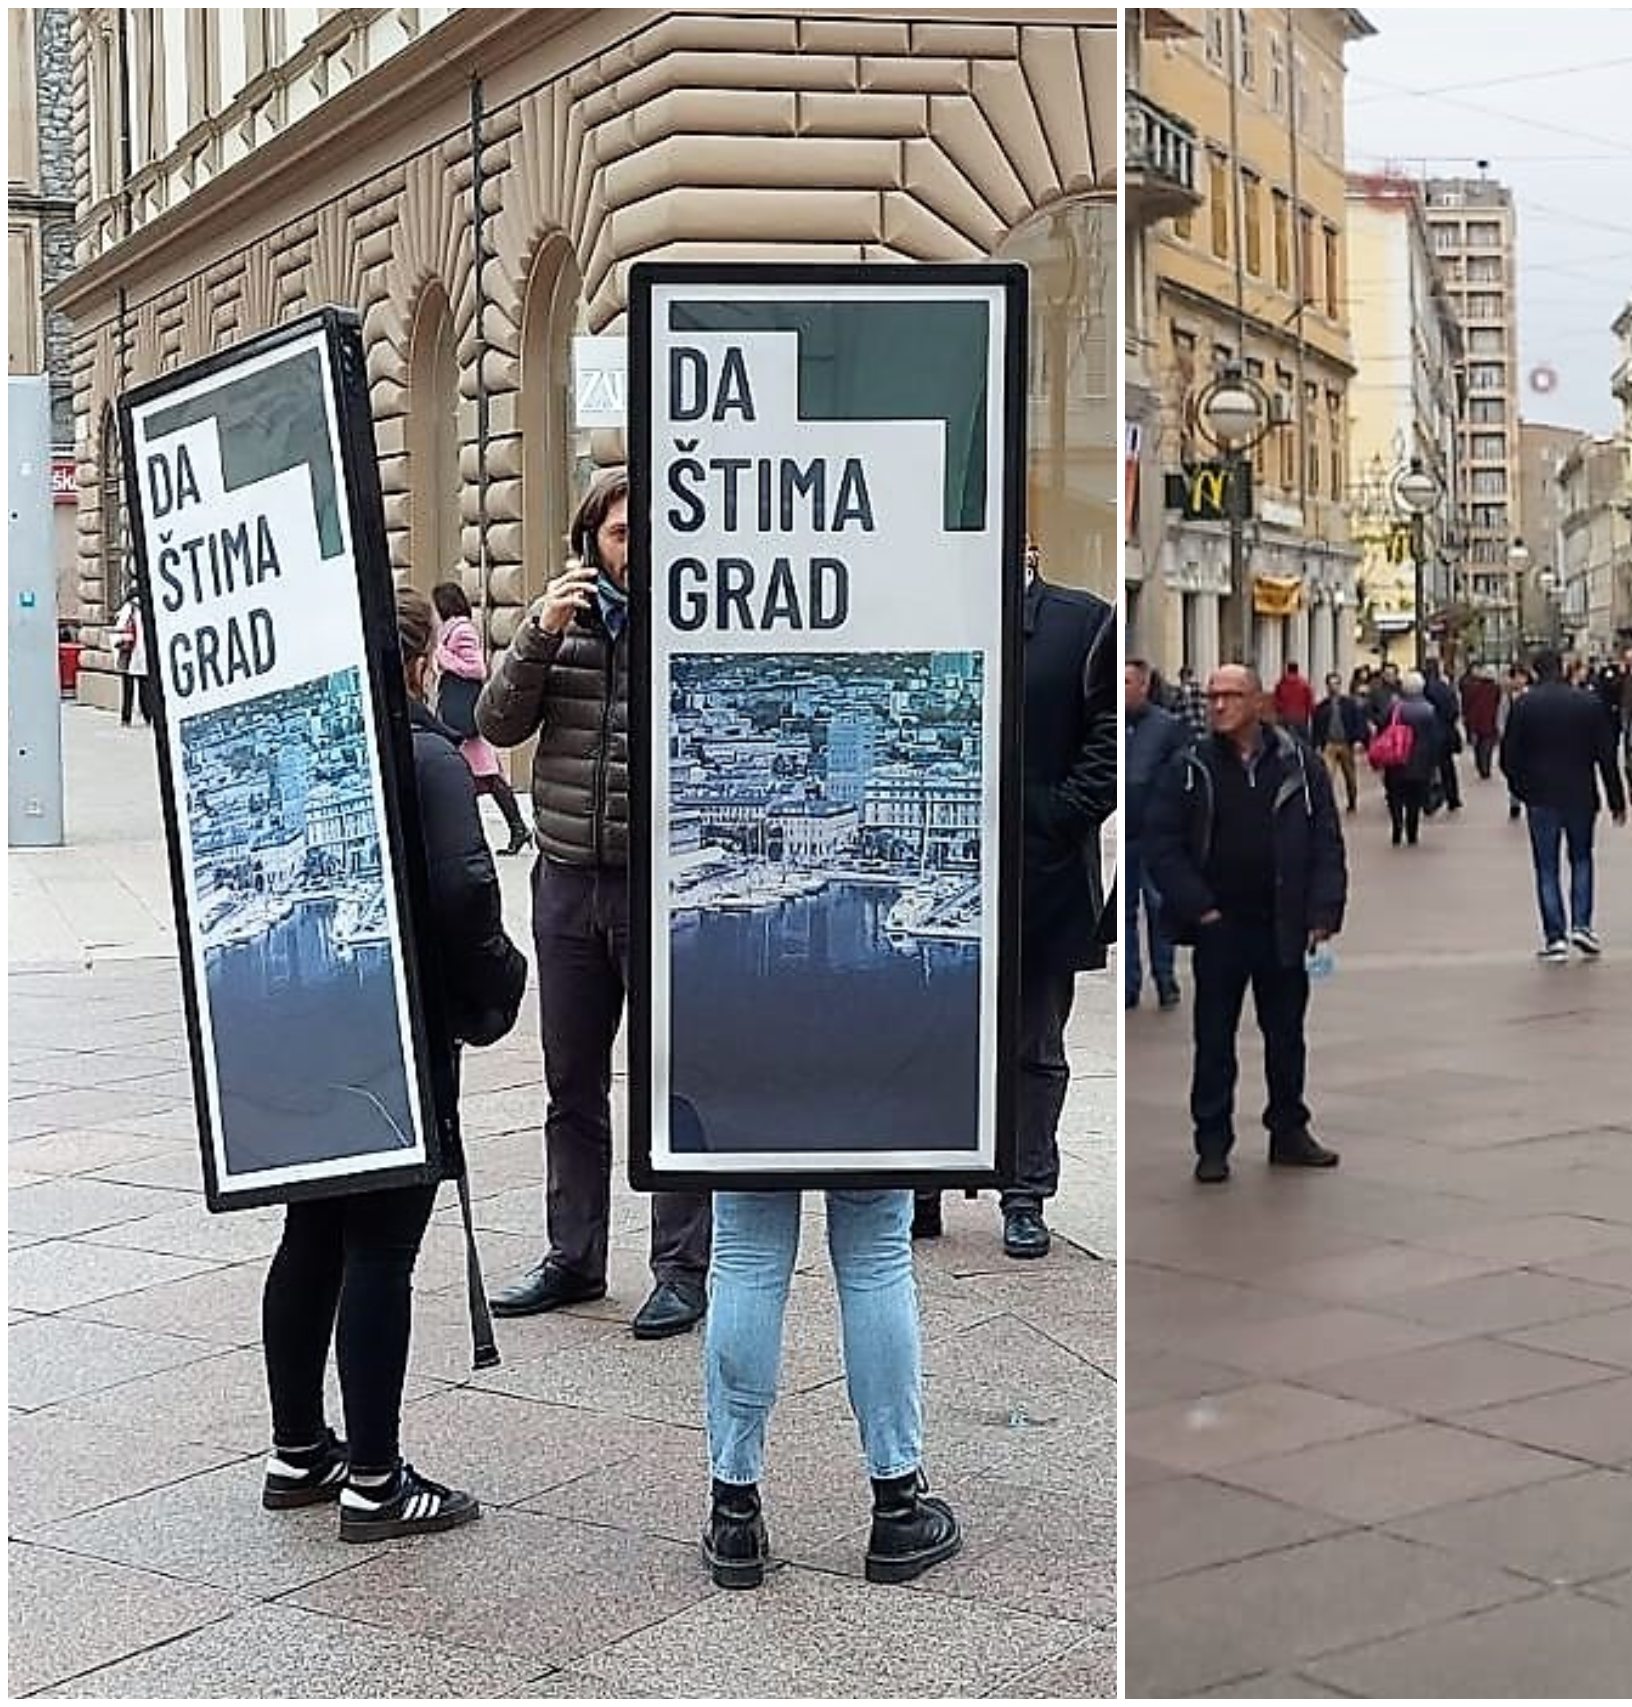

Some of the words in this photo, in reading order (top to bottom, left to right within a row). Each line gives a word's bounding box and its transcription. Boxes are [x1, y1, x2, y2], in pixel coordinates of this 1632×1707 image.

[668, 346, 757, 421] DA
[147, 443, 201, 519] DA
[667, 438, 876, 533] ŠTIMA
[157, 514, 282, 613] ŠTIMA
[667, 557, 850, 631] GRAD
[167, 606, 277, 698] GRAD
